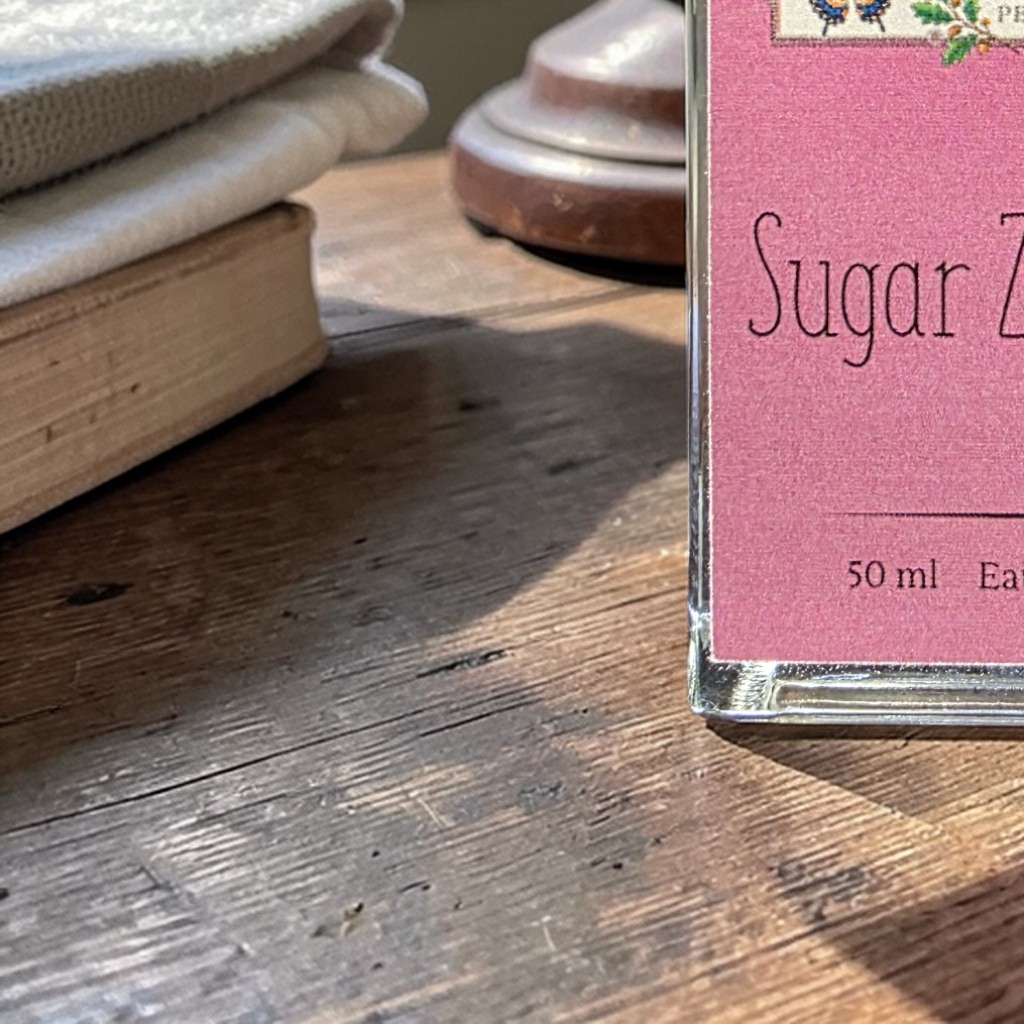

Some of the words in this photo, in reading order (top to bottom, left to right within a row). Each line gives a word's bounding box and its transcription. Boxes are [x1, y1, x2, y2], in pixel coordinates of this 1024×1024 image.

[749, 211, 971, 367] Sugar
[847, 560, 885, 589] 50
[896, 559, 937, 589] ml
